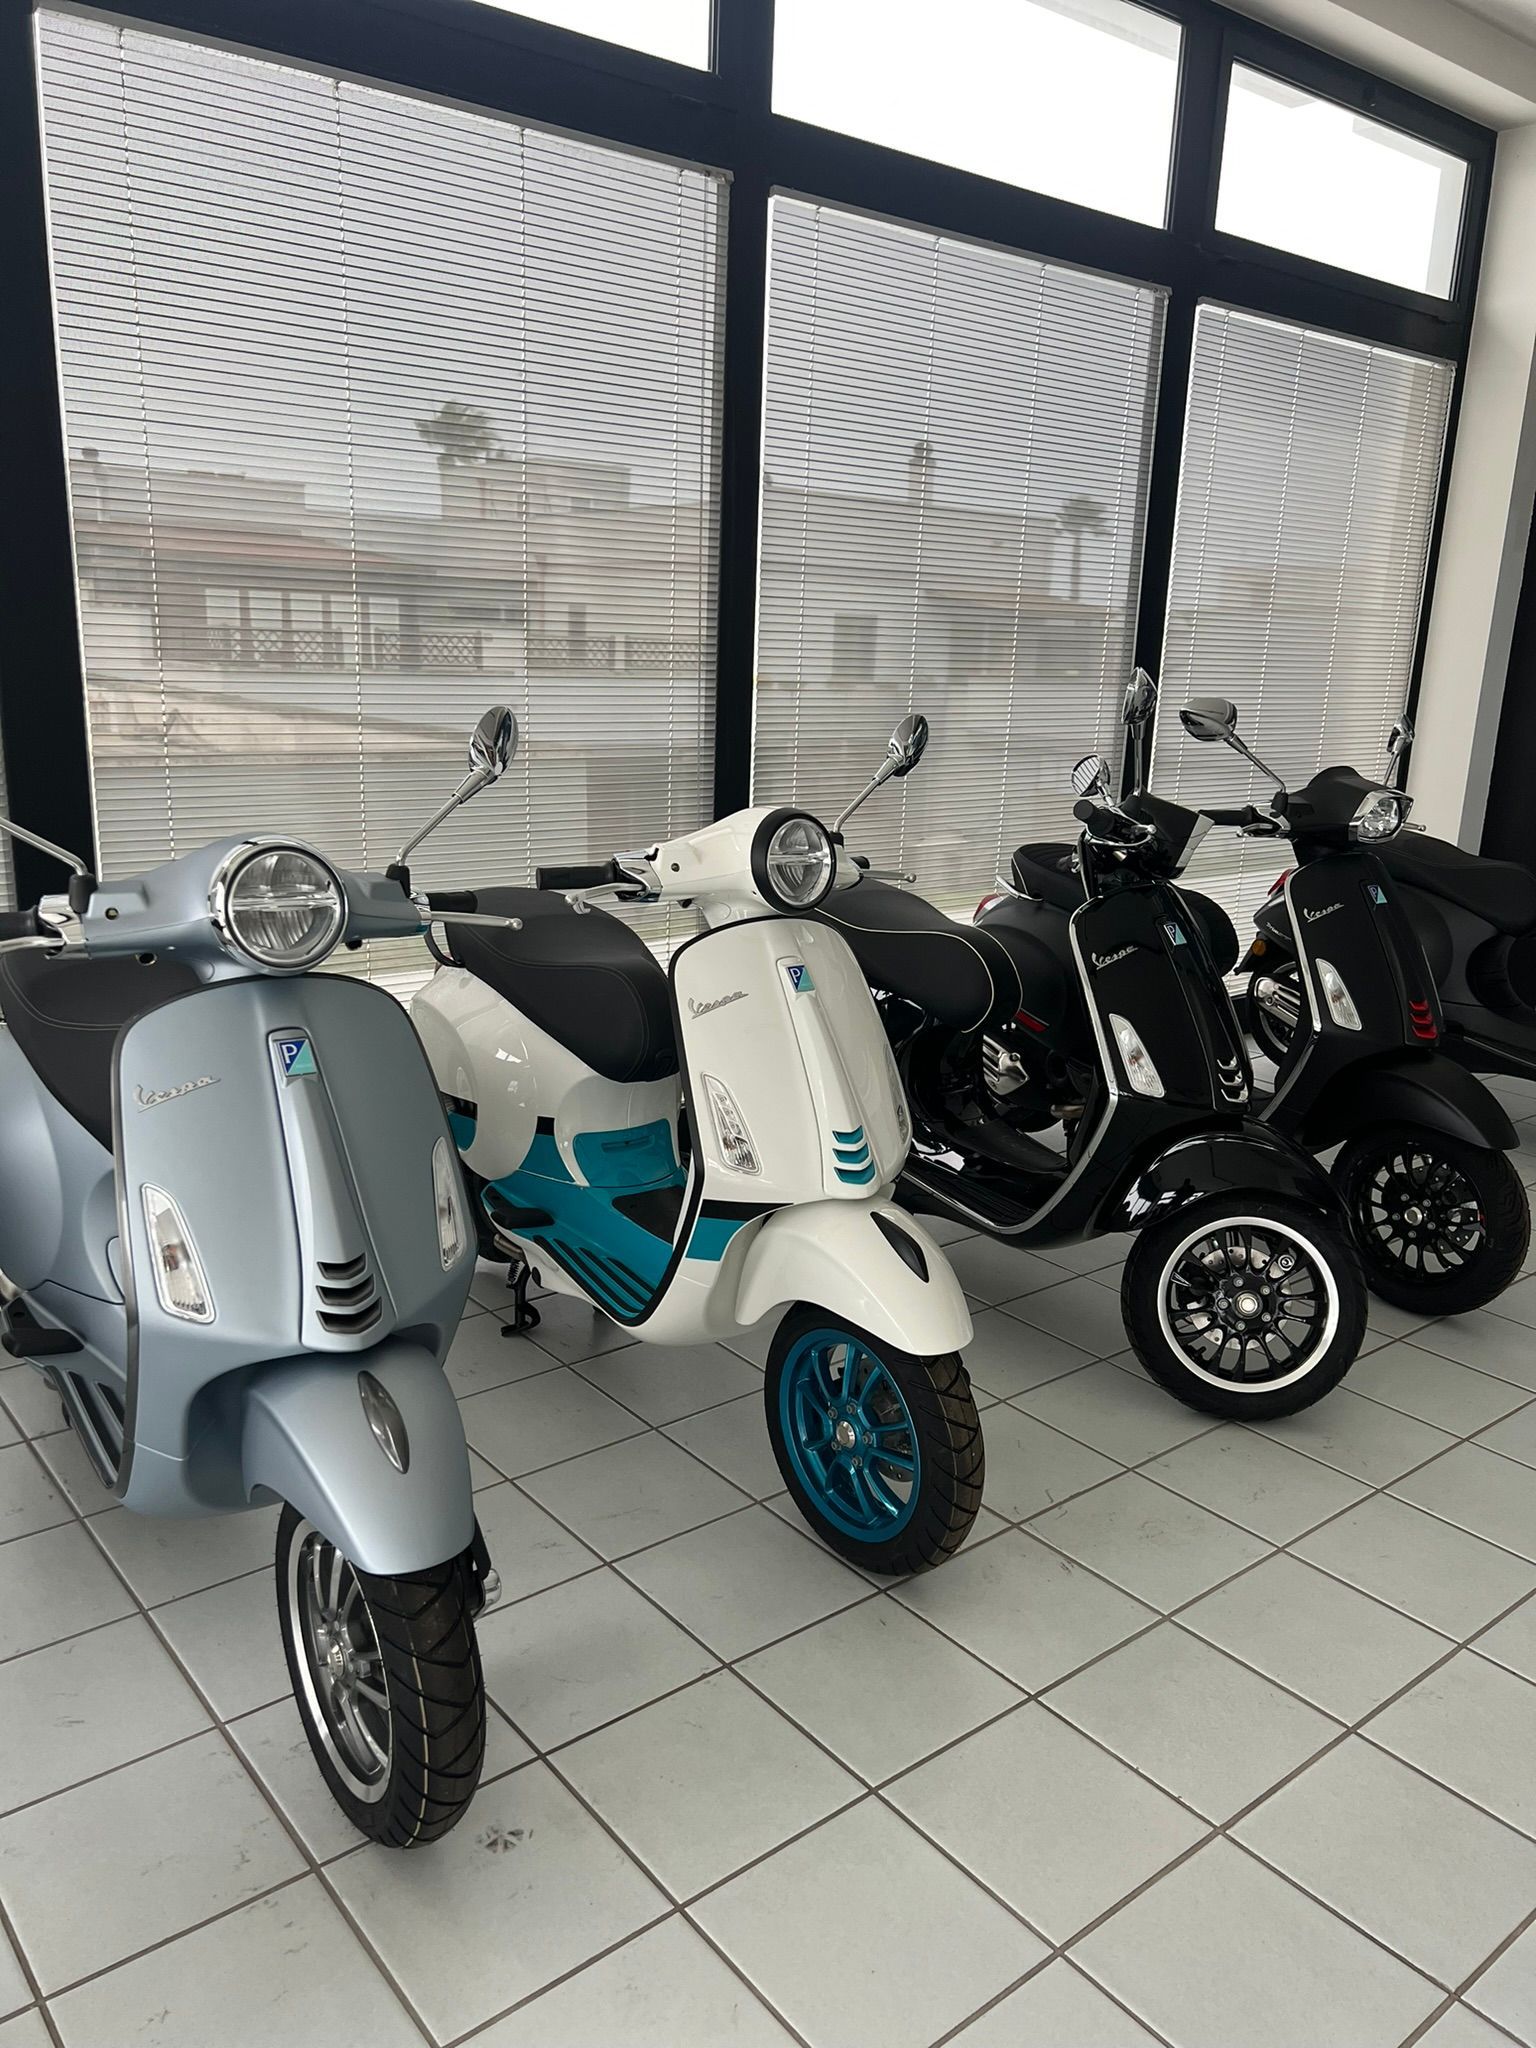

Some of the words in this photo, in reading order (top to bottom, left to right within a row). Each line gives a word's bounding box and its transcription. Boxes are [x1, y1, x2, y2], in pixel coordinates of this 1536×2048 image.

[1303, 903, 1345, 923] Vespa
[1091, 945, 1138, 970] Vespa
[789, 967, 801, 983] P
[688, 991, 750, 1020] Vespa
[281, 1043, 298, 1064] P
[132, 1075, 222, 1114] Vespa
